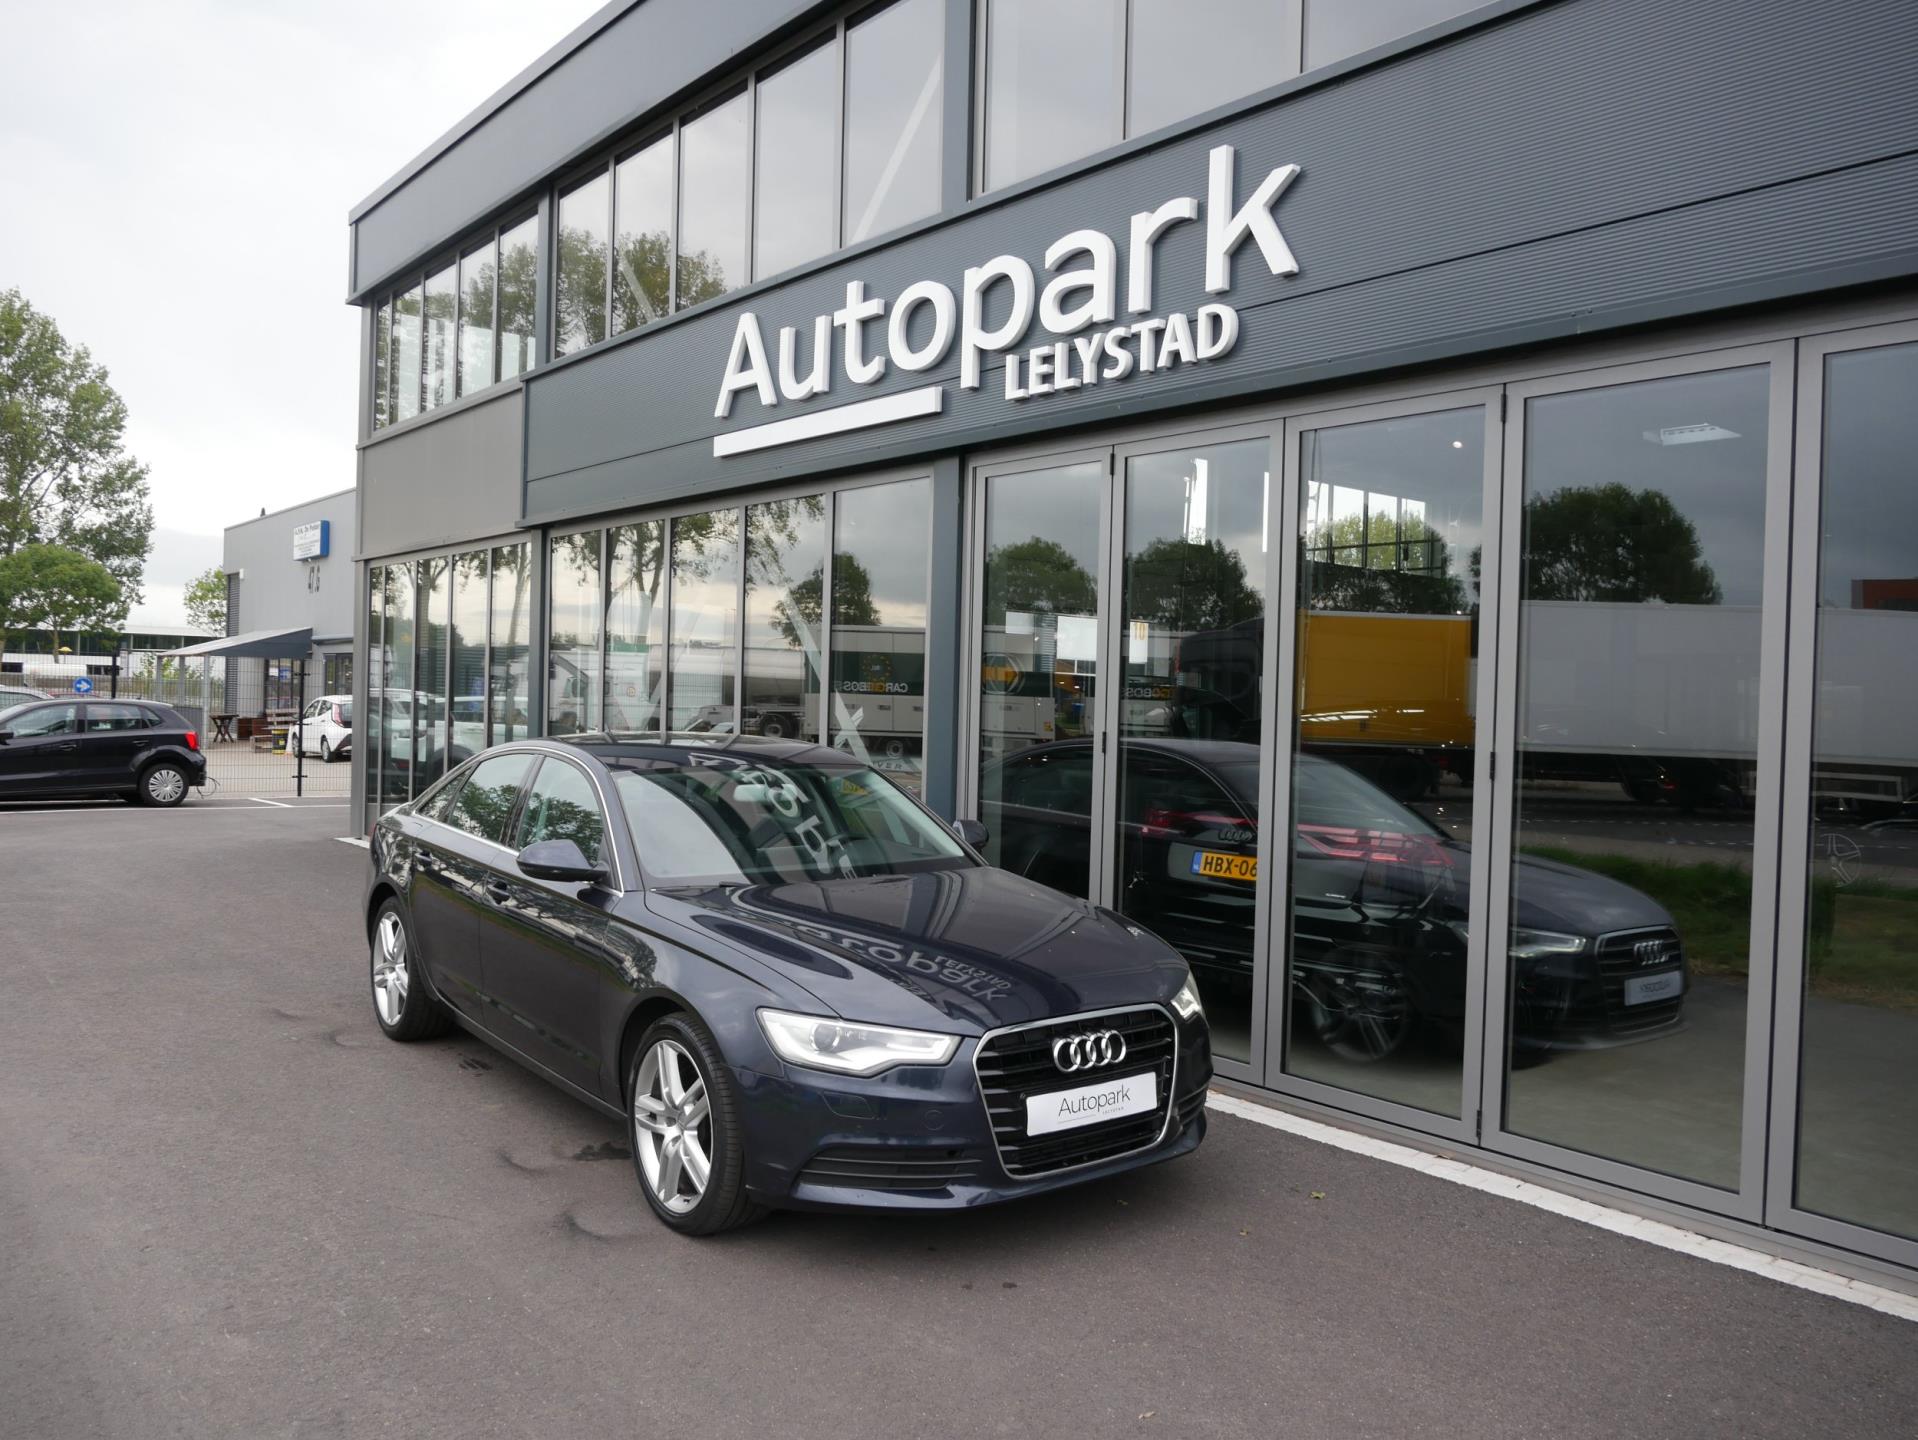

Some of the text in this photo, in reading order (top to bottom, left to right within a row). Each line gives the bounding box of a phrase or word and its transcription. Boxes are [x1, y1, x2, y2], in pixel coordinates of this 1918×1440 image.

[714, 144, 1300, 418] Autopark
[1005, 303, 1240, 401] LELYSTAD
[1058, 1083, 1131, 1117] Autopark
